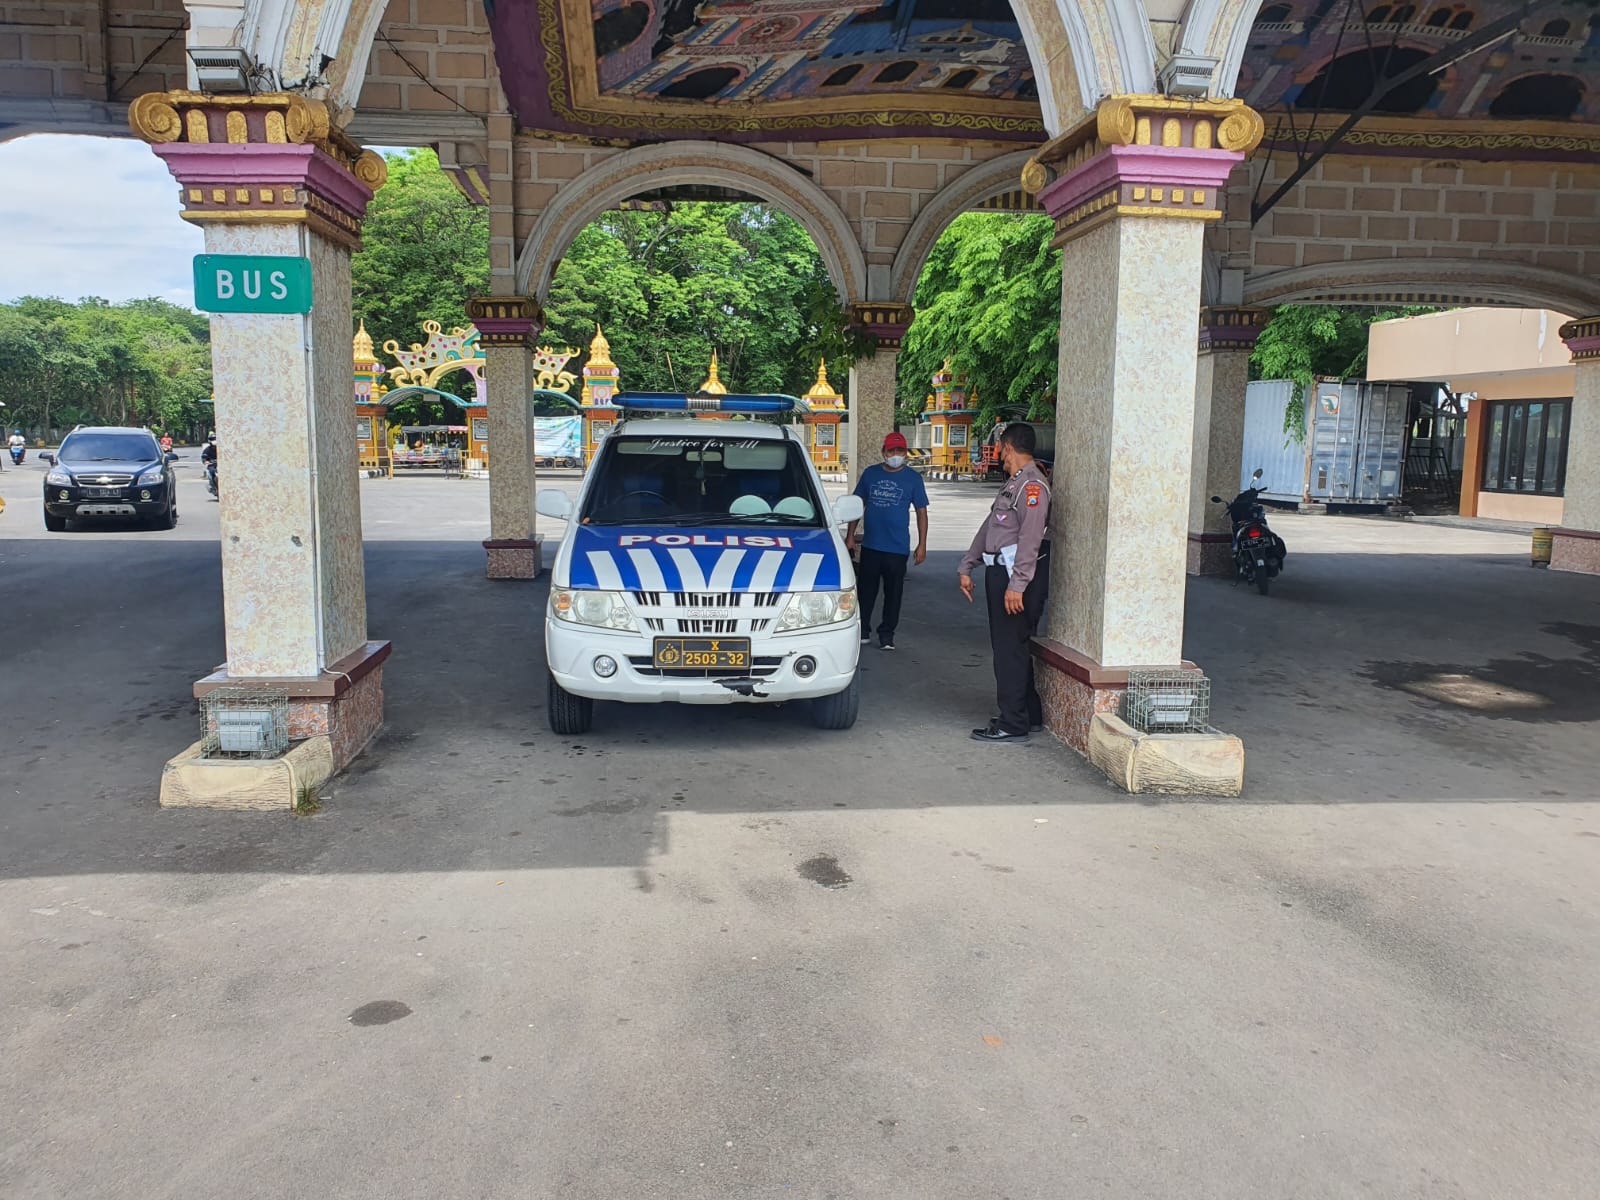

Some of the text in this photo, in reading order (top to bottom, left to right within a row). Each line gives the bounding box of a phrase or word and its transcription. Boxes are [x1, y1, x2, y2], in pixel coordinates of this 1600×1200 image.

[216, 269, 288, 300] BUS
[646, 438, 760, 451] Justice for All
[618, 534, 793, 549] POLISI
[711, 641, 720, 651] X
